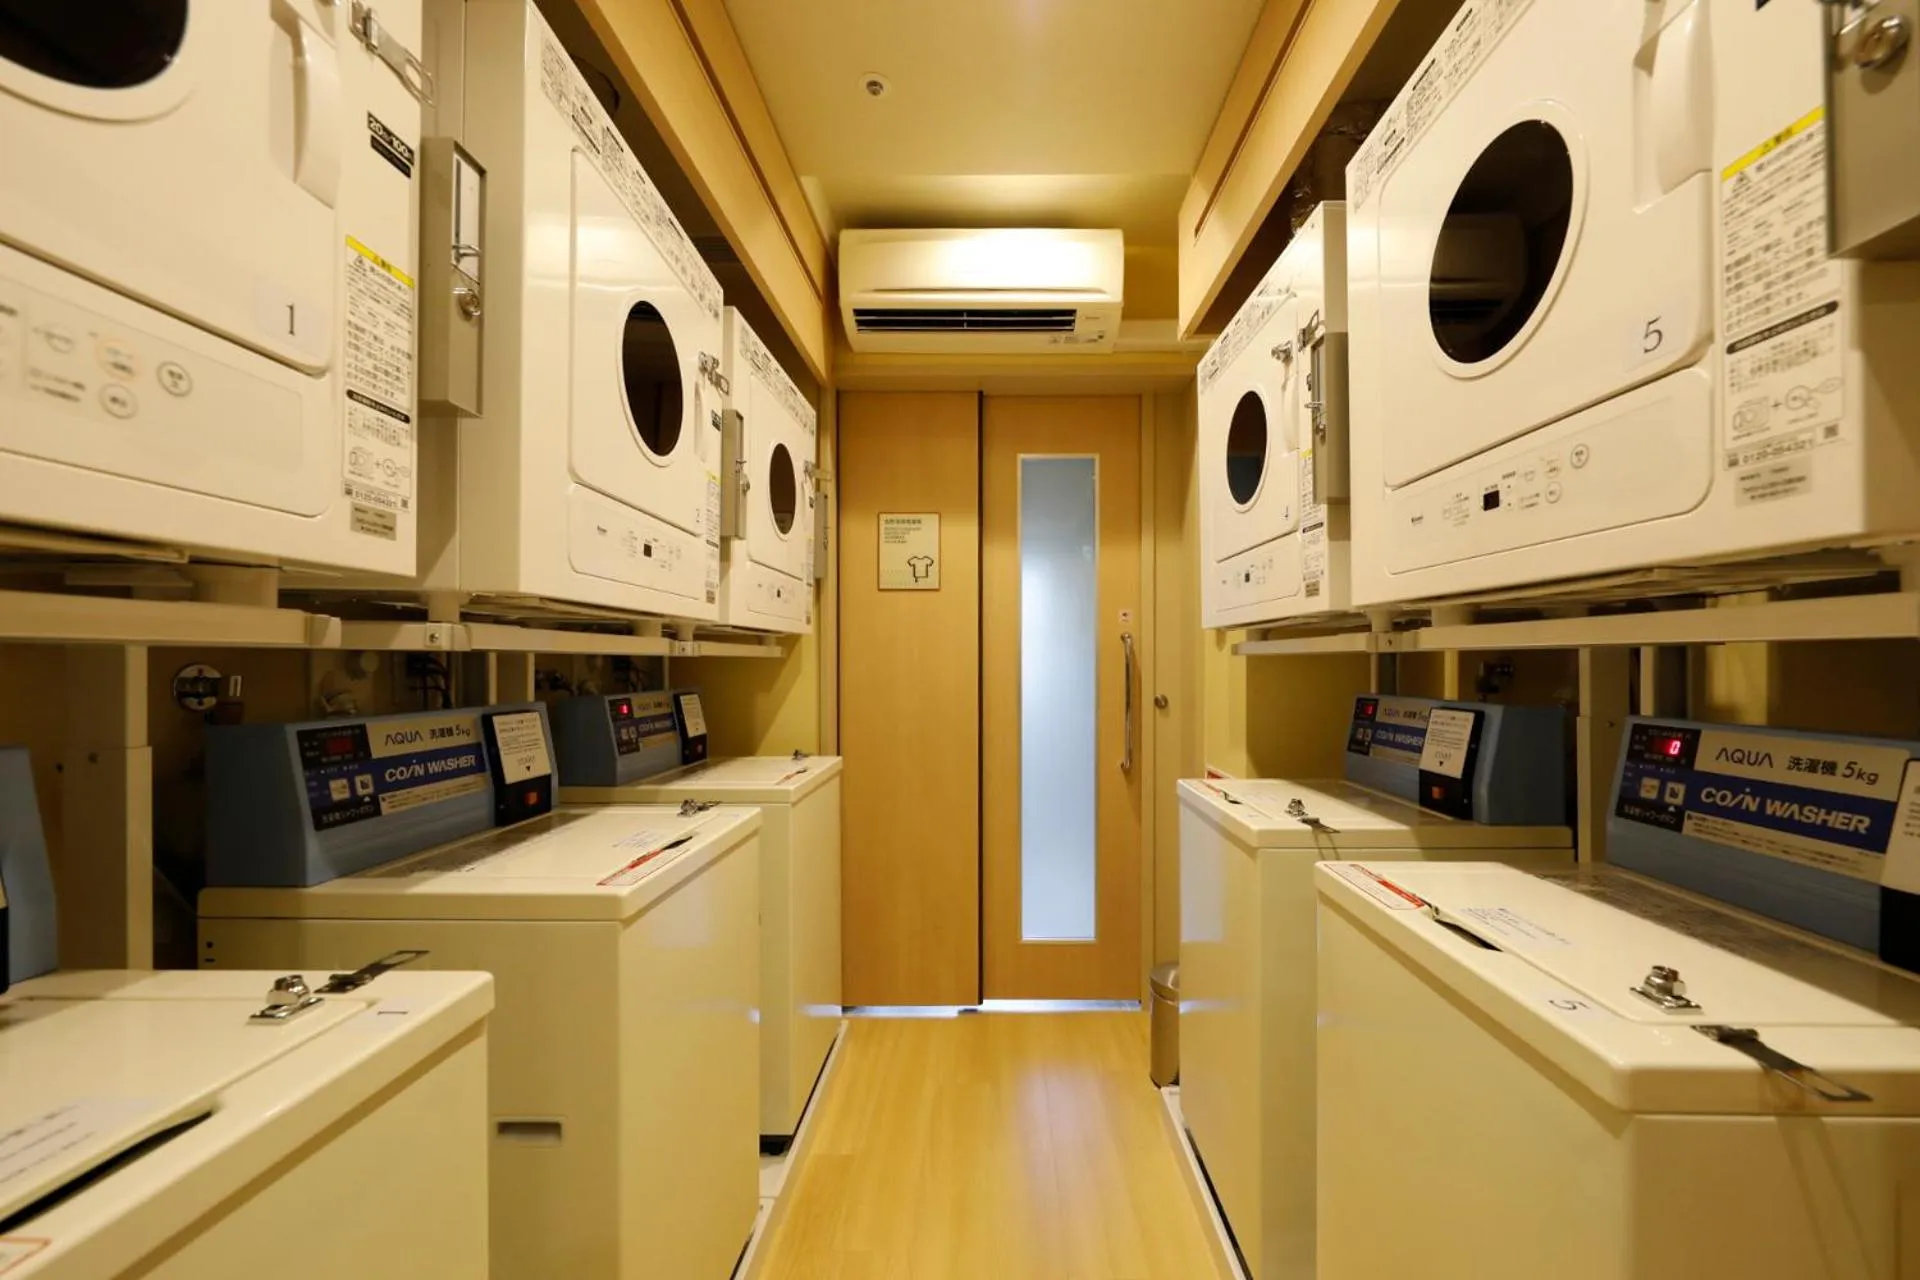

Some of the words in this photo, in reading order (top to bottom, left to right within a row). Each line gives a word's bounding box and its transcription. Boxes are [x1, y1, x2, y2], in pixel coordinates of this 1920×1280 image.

[286, 303, 295, 337] 1
[1643, 316, 1663, 354] 5
[385, 730, 424, 745] AQUA
[1670, 740, 1681, 755] 0
[384, 759, 425, 783] COIN
[427, 754, 476, 775] WASHER
[1715, 747, 1774, 769] AQUA
[1786, 755, 1838, 777] 洗濯機
[1842, 761, 1880, 786] 5kg
[1700, 787, 1762, 813] COIN
[1765, 797, 1873, 836] WASHER
[1548, 999, 1592, 1011] 5
